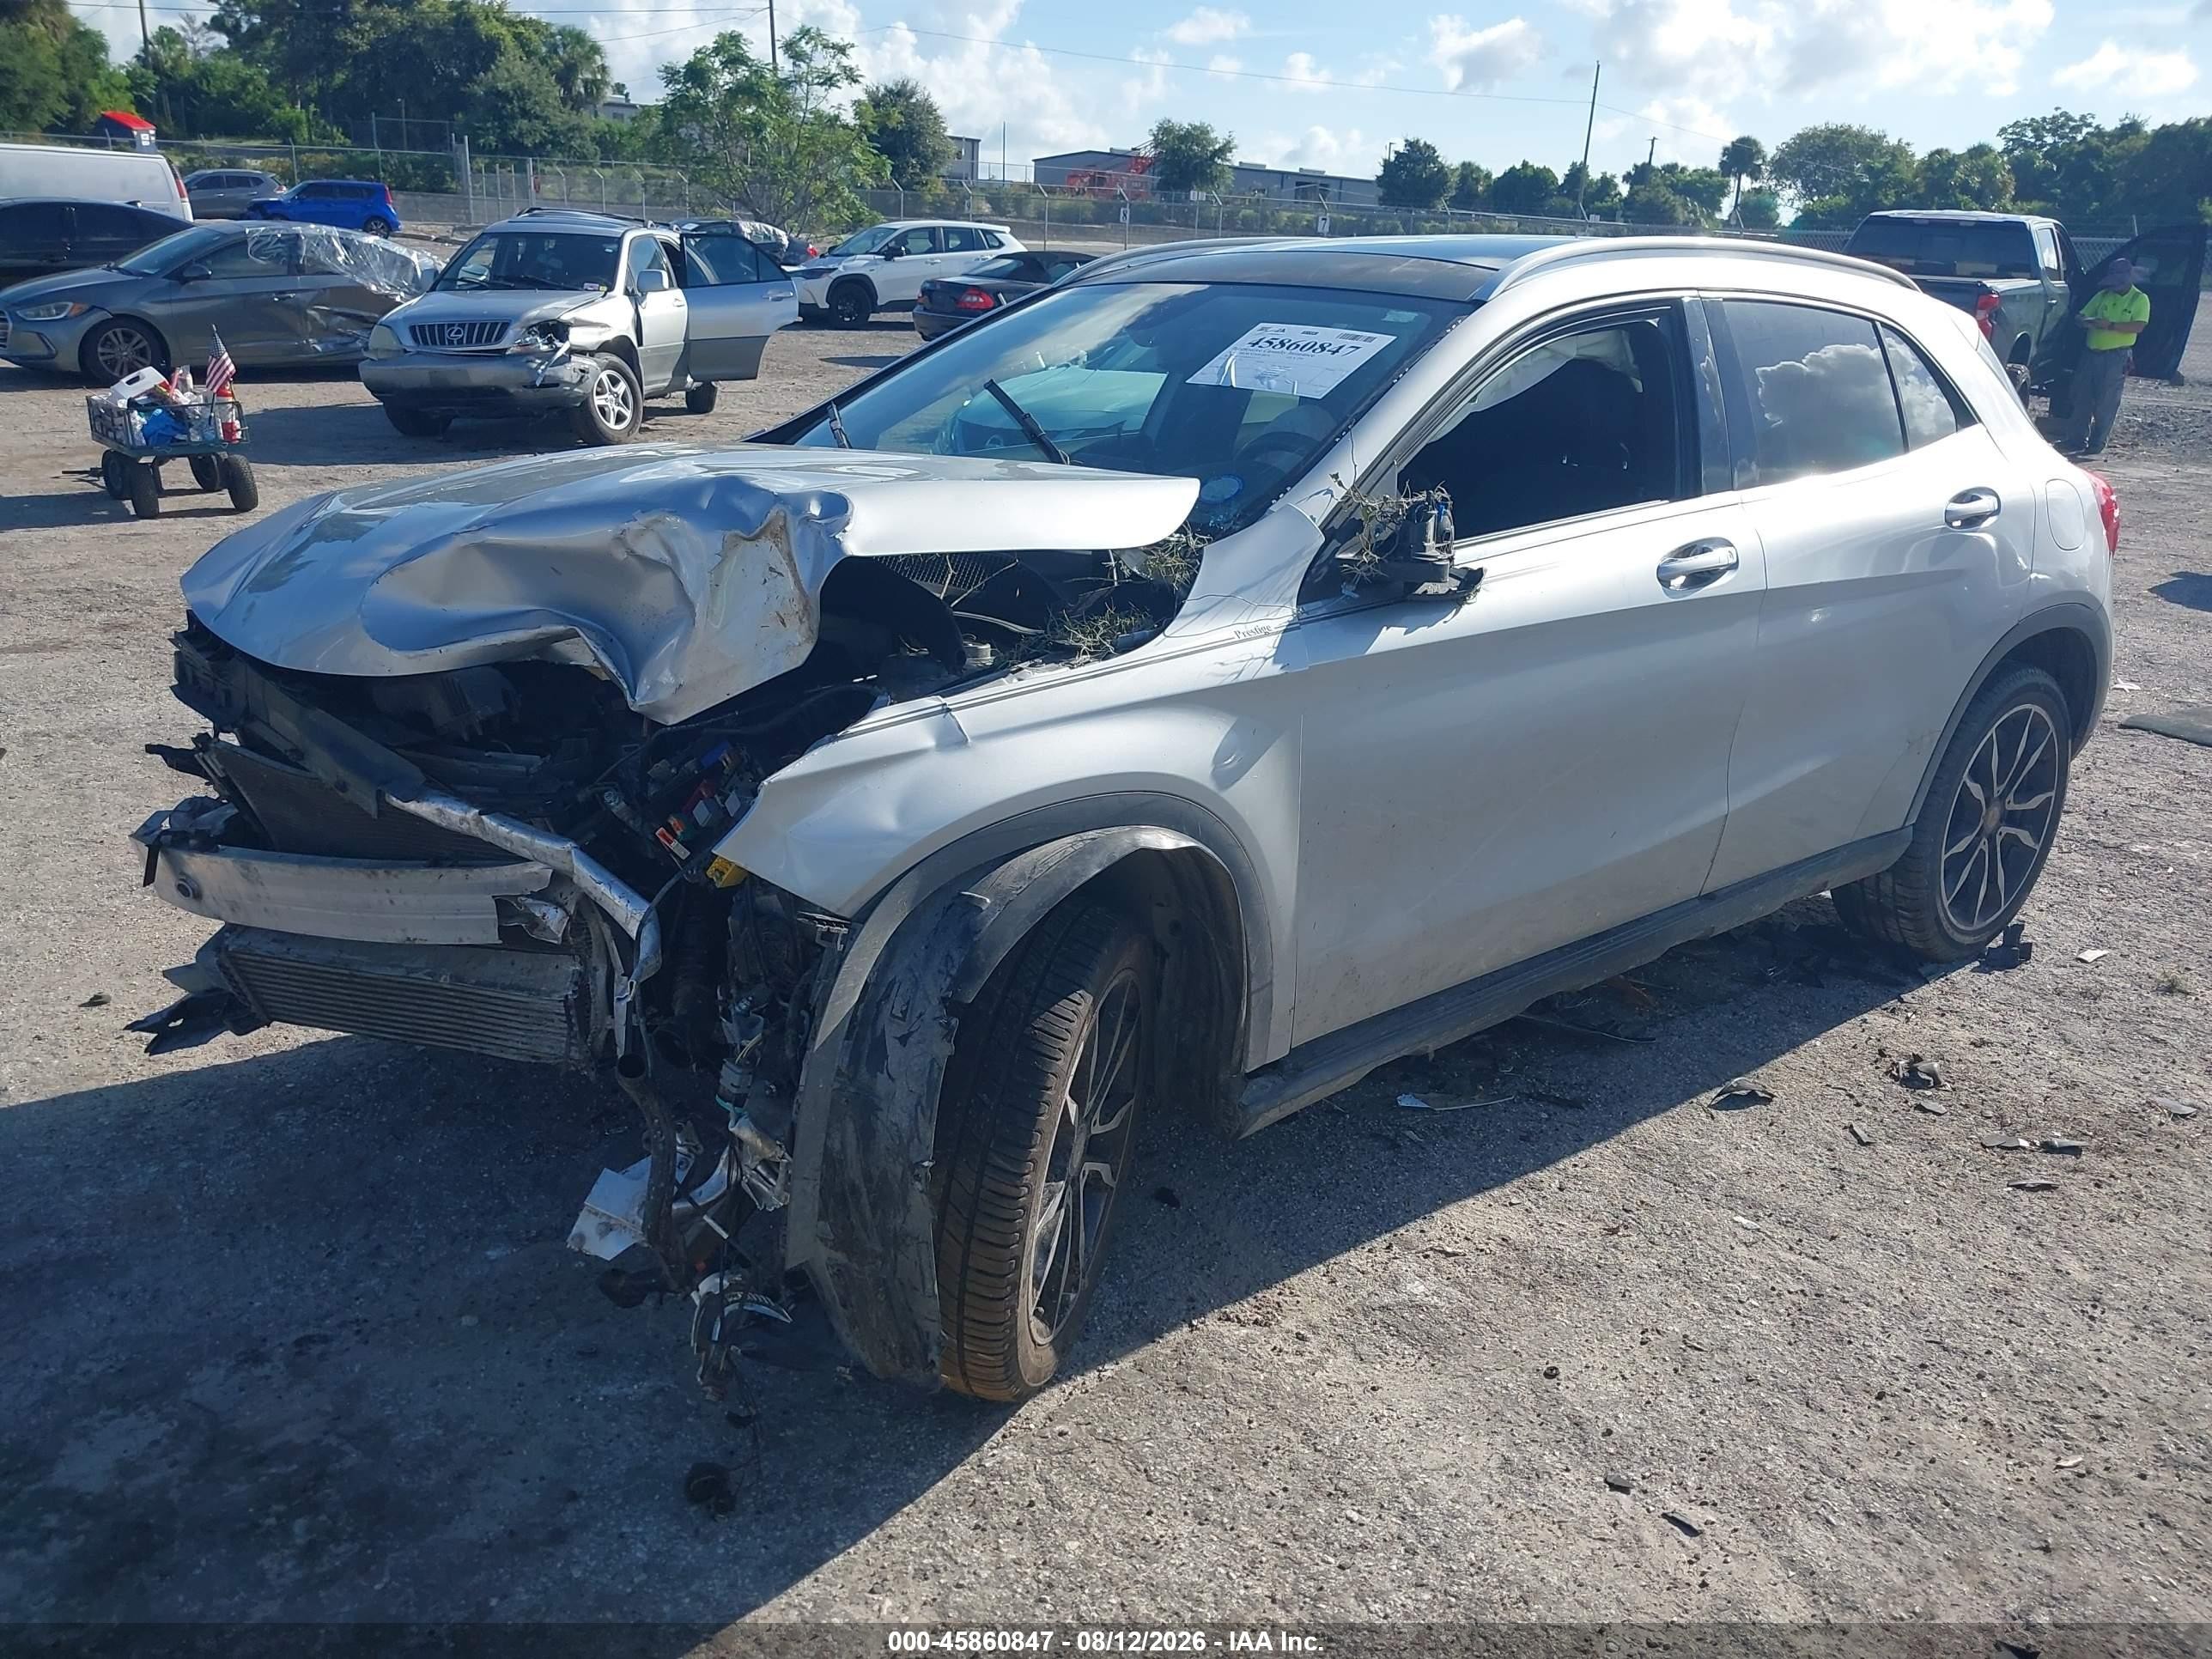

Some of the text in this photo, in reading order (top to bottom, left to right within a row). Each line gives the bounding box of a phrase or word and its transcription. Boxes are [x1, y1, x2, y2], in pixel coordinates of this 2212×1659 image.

[1121, 210, 1128, 221] 8
[1321, 217, 1328, 230] 7
[1246, 336, 1364, 356] 45860847
[1233, 624, 1273, 640] Prestige
